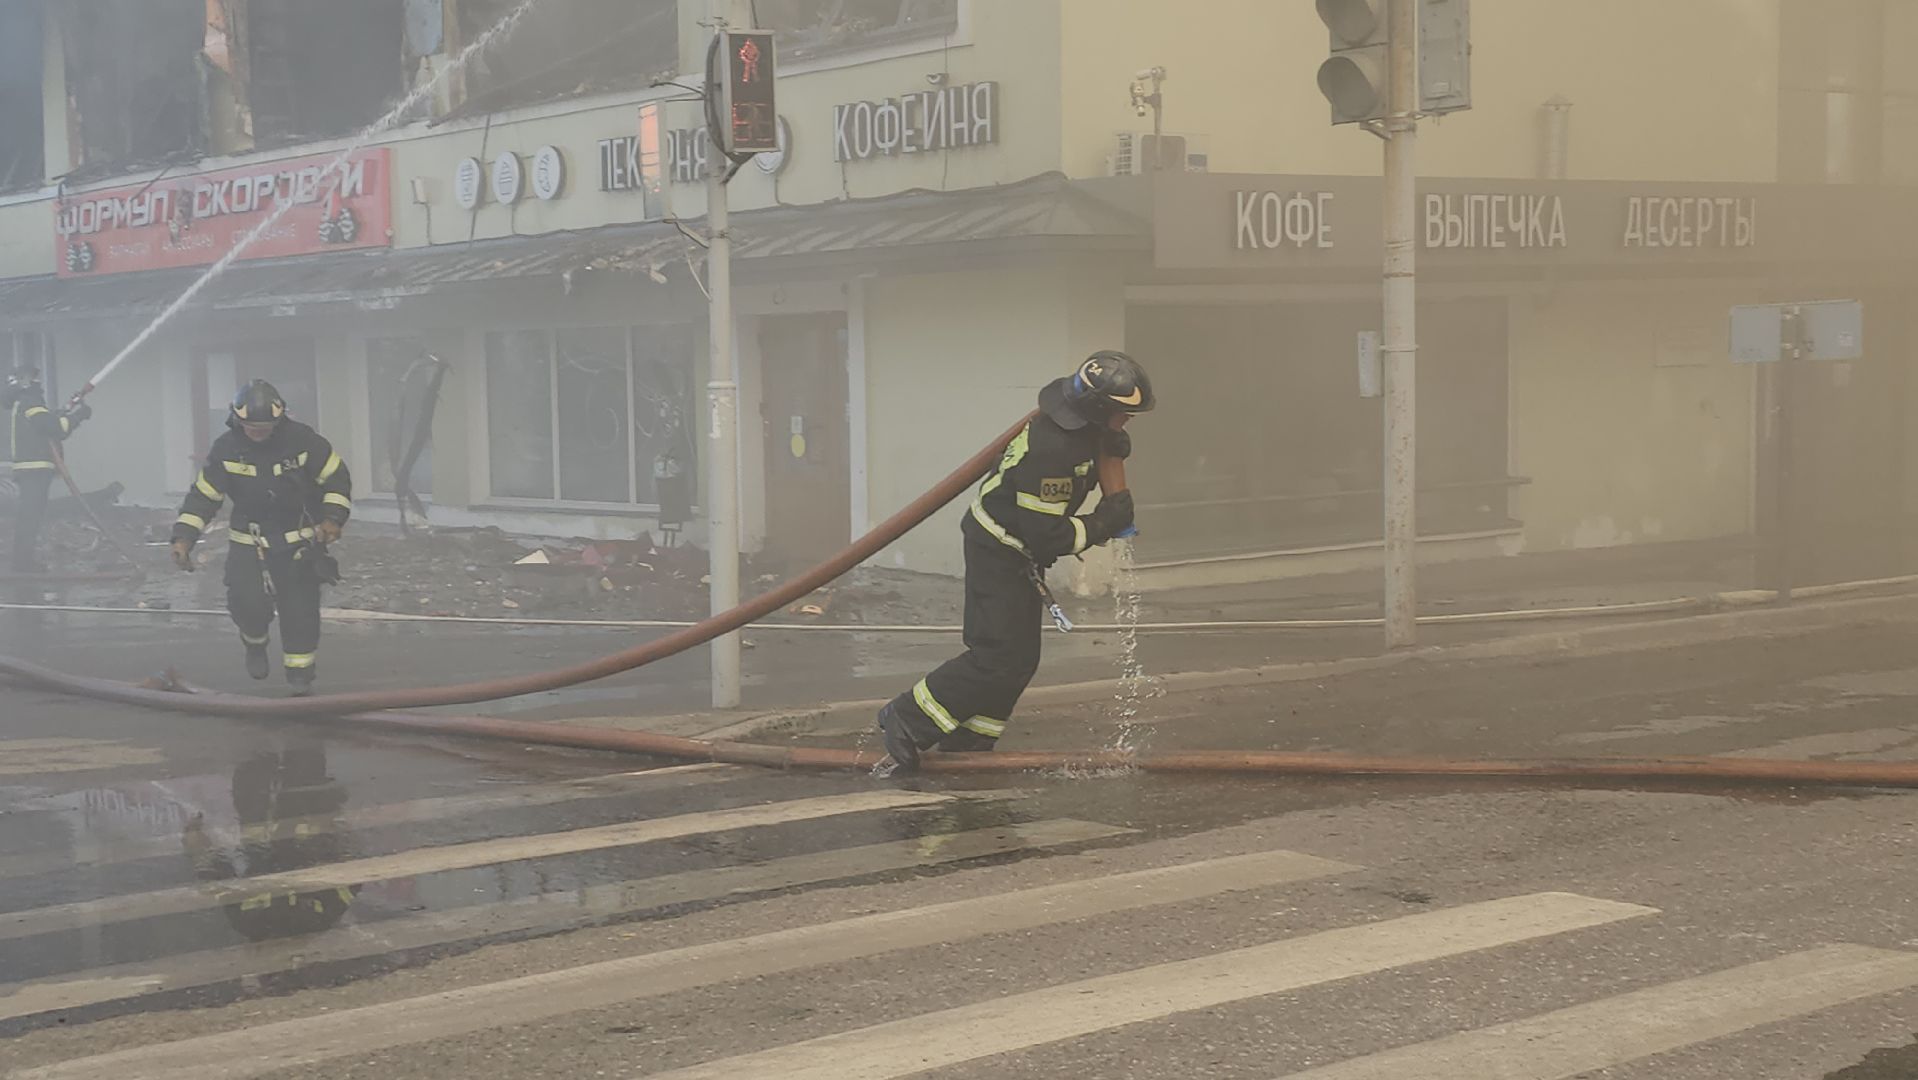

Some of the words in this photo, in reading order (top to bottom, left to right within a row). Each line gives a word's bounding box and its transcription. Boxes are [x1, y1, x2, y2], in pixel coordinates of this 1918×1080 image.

[833, 73, 996, 161] КОФЕЙНЯ
[598, 127, 708, 190] ПЕКРНЯ
[1235, 191, 1335, 249] КОФЕ
[1424, 193, 1567, 248] ВЫПЕЧКА
[1622, 196, 1757, 248] ДЕСЕРТЫ
